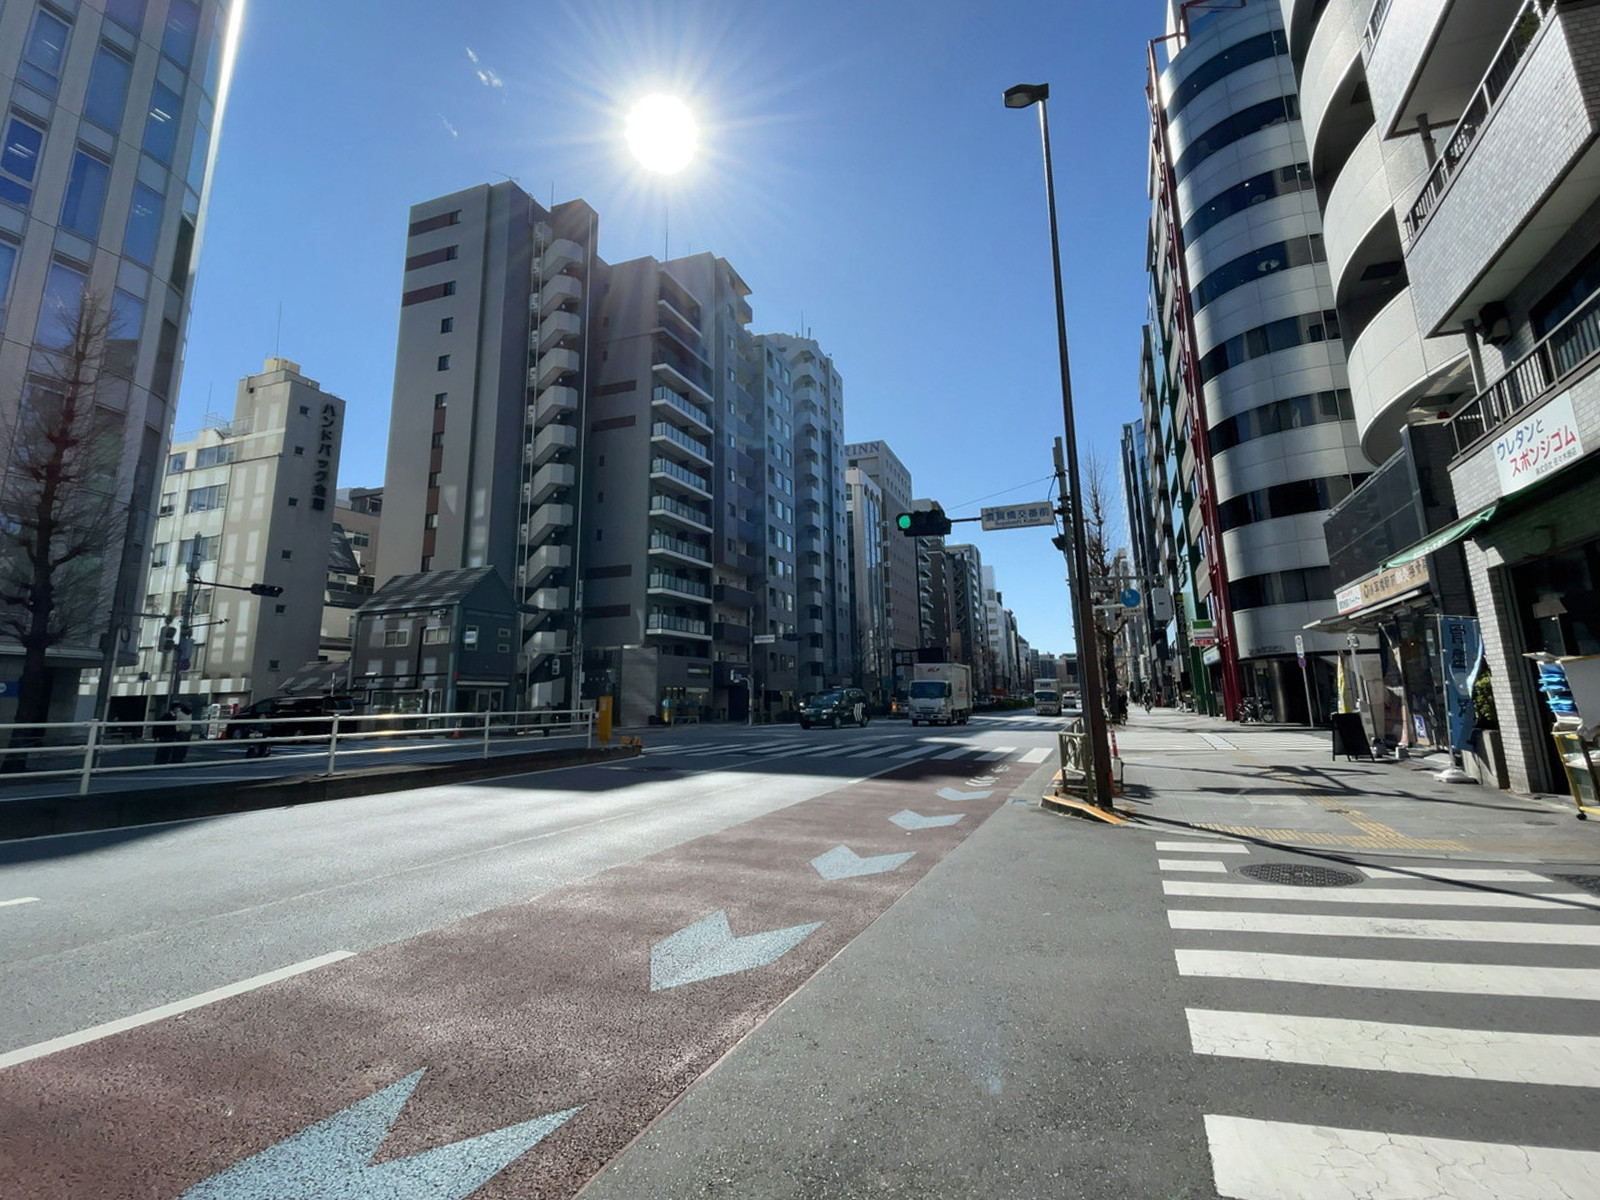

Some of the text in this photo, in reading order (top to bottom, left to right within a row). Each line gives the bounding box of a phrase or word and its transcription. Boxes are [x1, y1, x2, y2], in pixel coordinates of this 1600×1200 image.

[1497, 419, 1544, 461] ウレタンと
[1510, 425, 1576, 477] スポンジゴム
